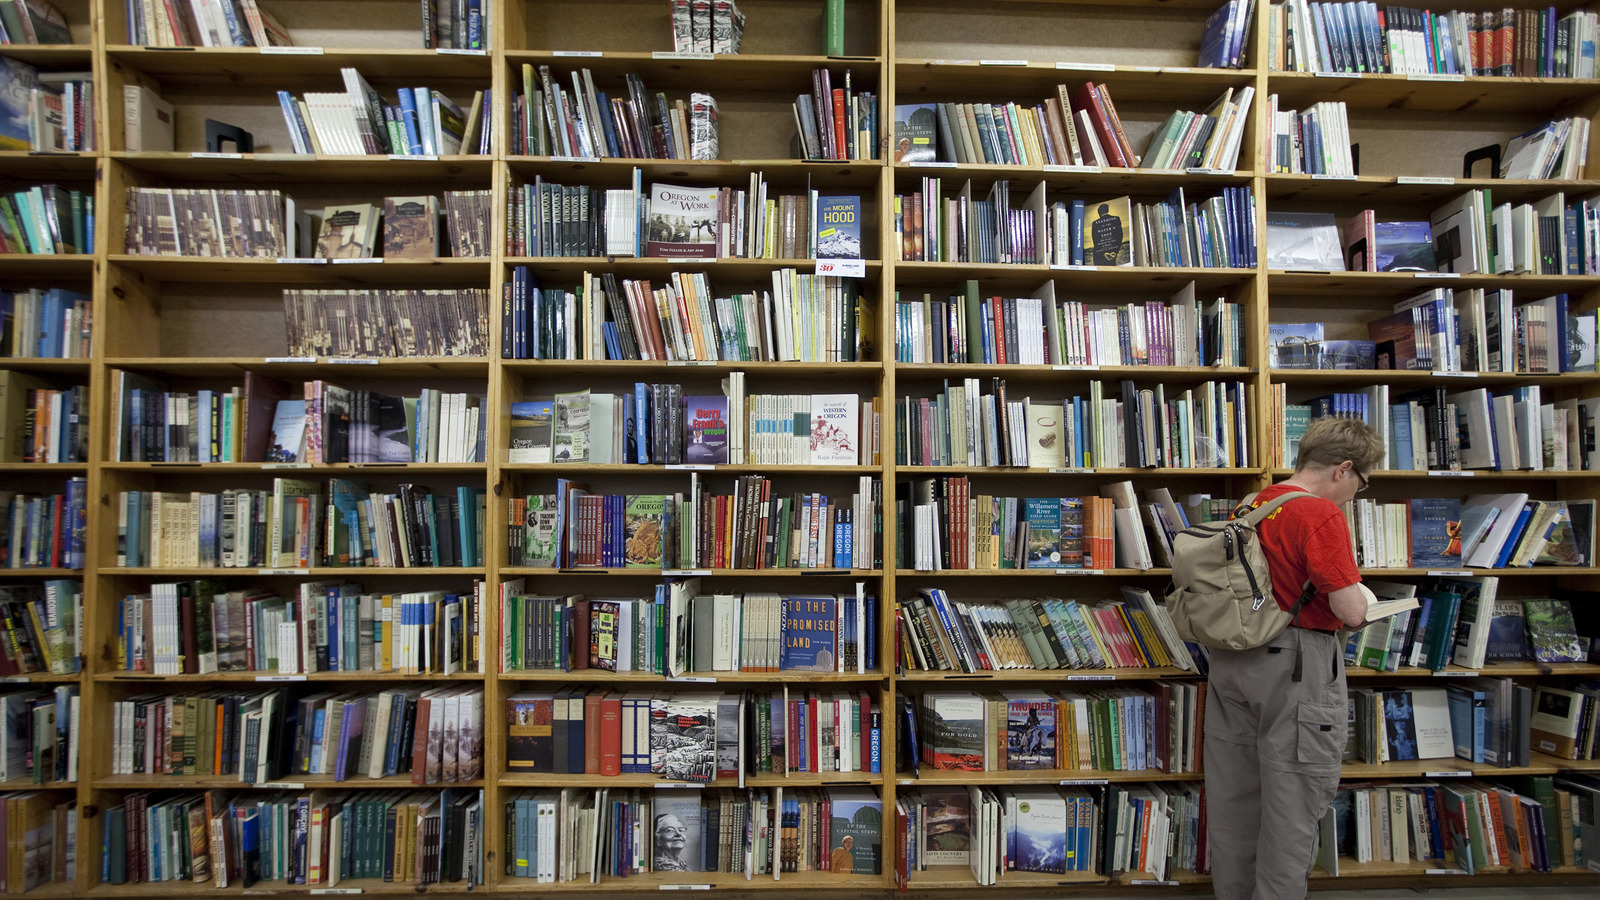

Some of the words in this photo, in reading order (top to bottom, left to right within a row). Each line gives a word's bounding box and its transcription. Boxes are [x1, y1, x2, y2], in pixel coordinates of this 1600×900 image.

[660, 191, 700, 202] OREGON
[680, 202, 709, 211] WORK
[824, 212, 854, 223] HOOD
[1270, 327, 1285, 335] ings
[696, 408, 720, 420] Gerry
[693, 419, 724, 429] Frank's
[788, 601, 801, 612] TO
[806, 602, 826, 613] THE
[787, 619, 834, 631] PROMISED
[787, 637, 810, 648] LAND
[1010, 703, 1052, 711] THUNDER
